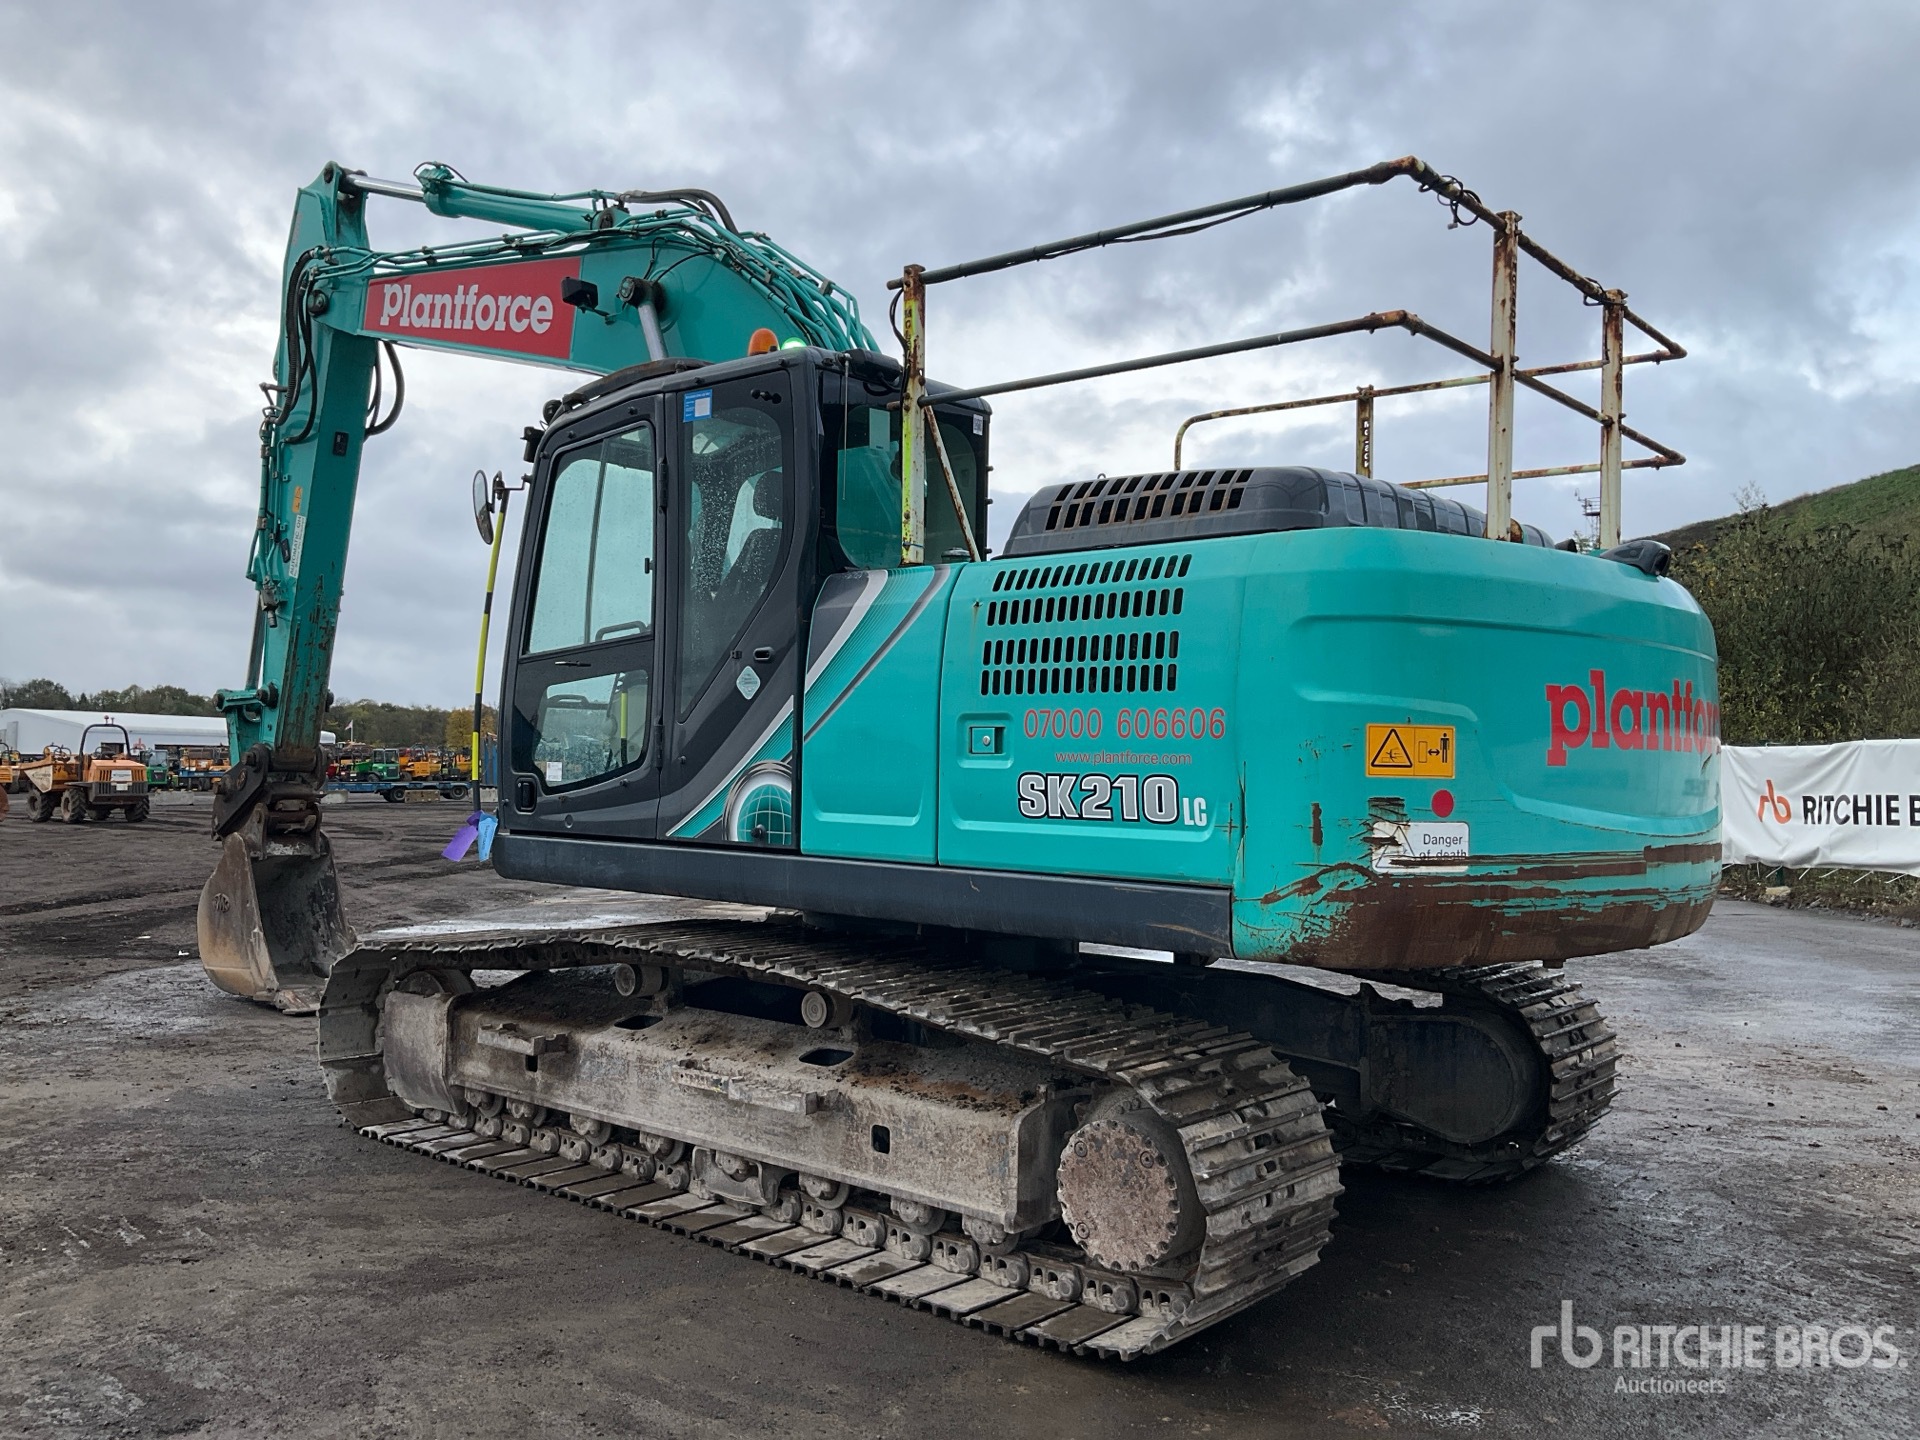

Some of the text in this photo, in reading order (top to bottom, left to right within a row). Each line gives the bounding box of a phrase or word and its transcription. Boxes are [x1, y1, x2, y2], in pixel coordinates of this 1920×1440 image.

[1023, 707, 1226, 740] 07000 606606
[1055, 750, 1192, 766] www.plantforce.com
[1018, 771, 1208, 827] SK210 LC
[1802, 794, 1900, 826] RITCHIE
[1423, 833, 1463, 847] Danger
